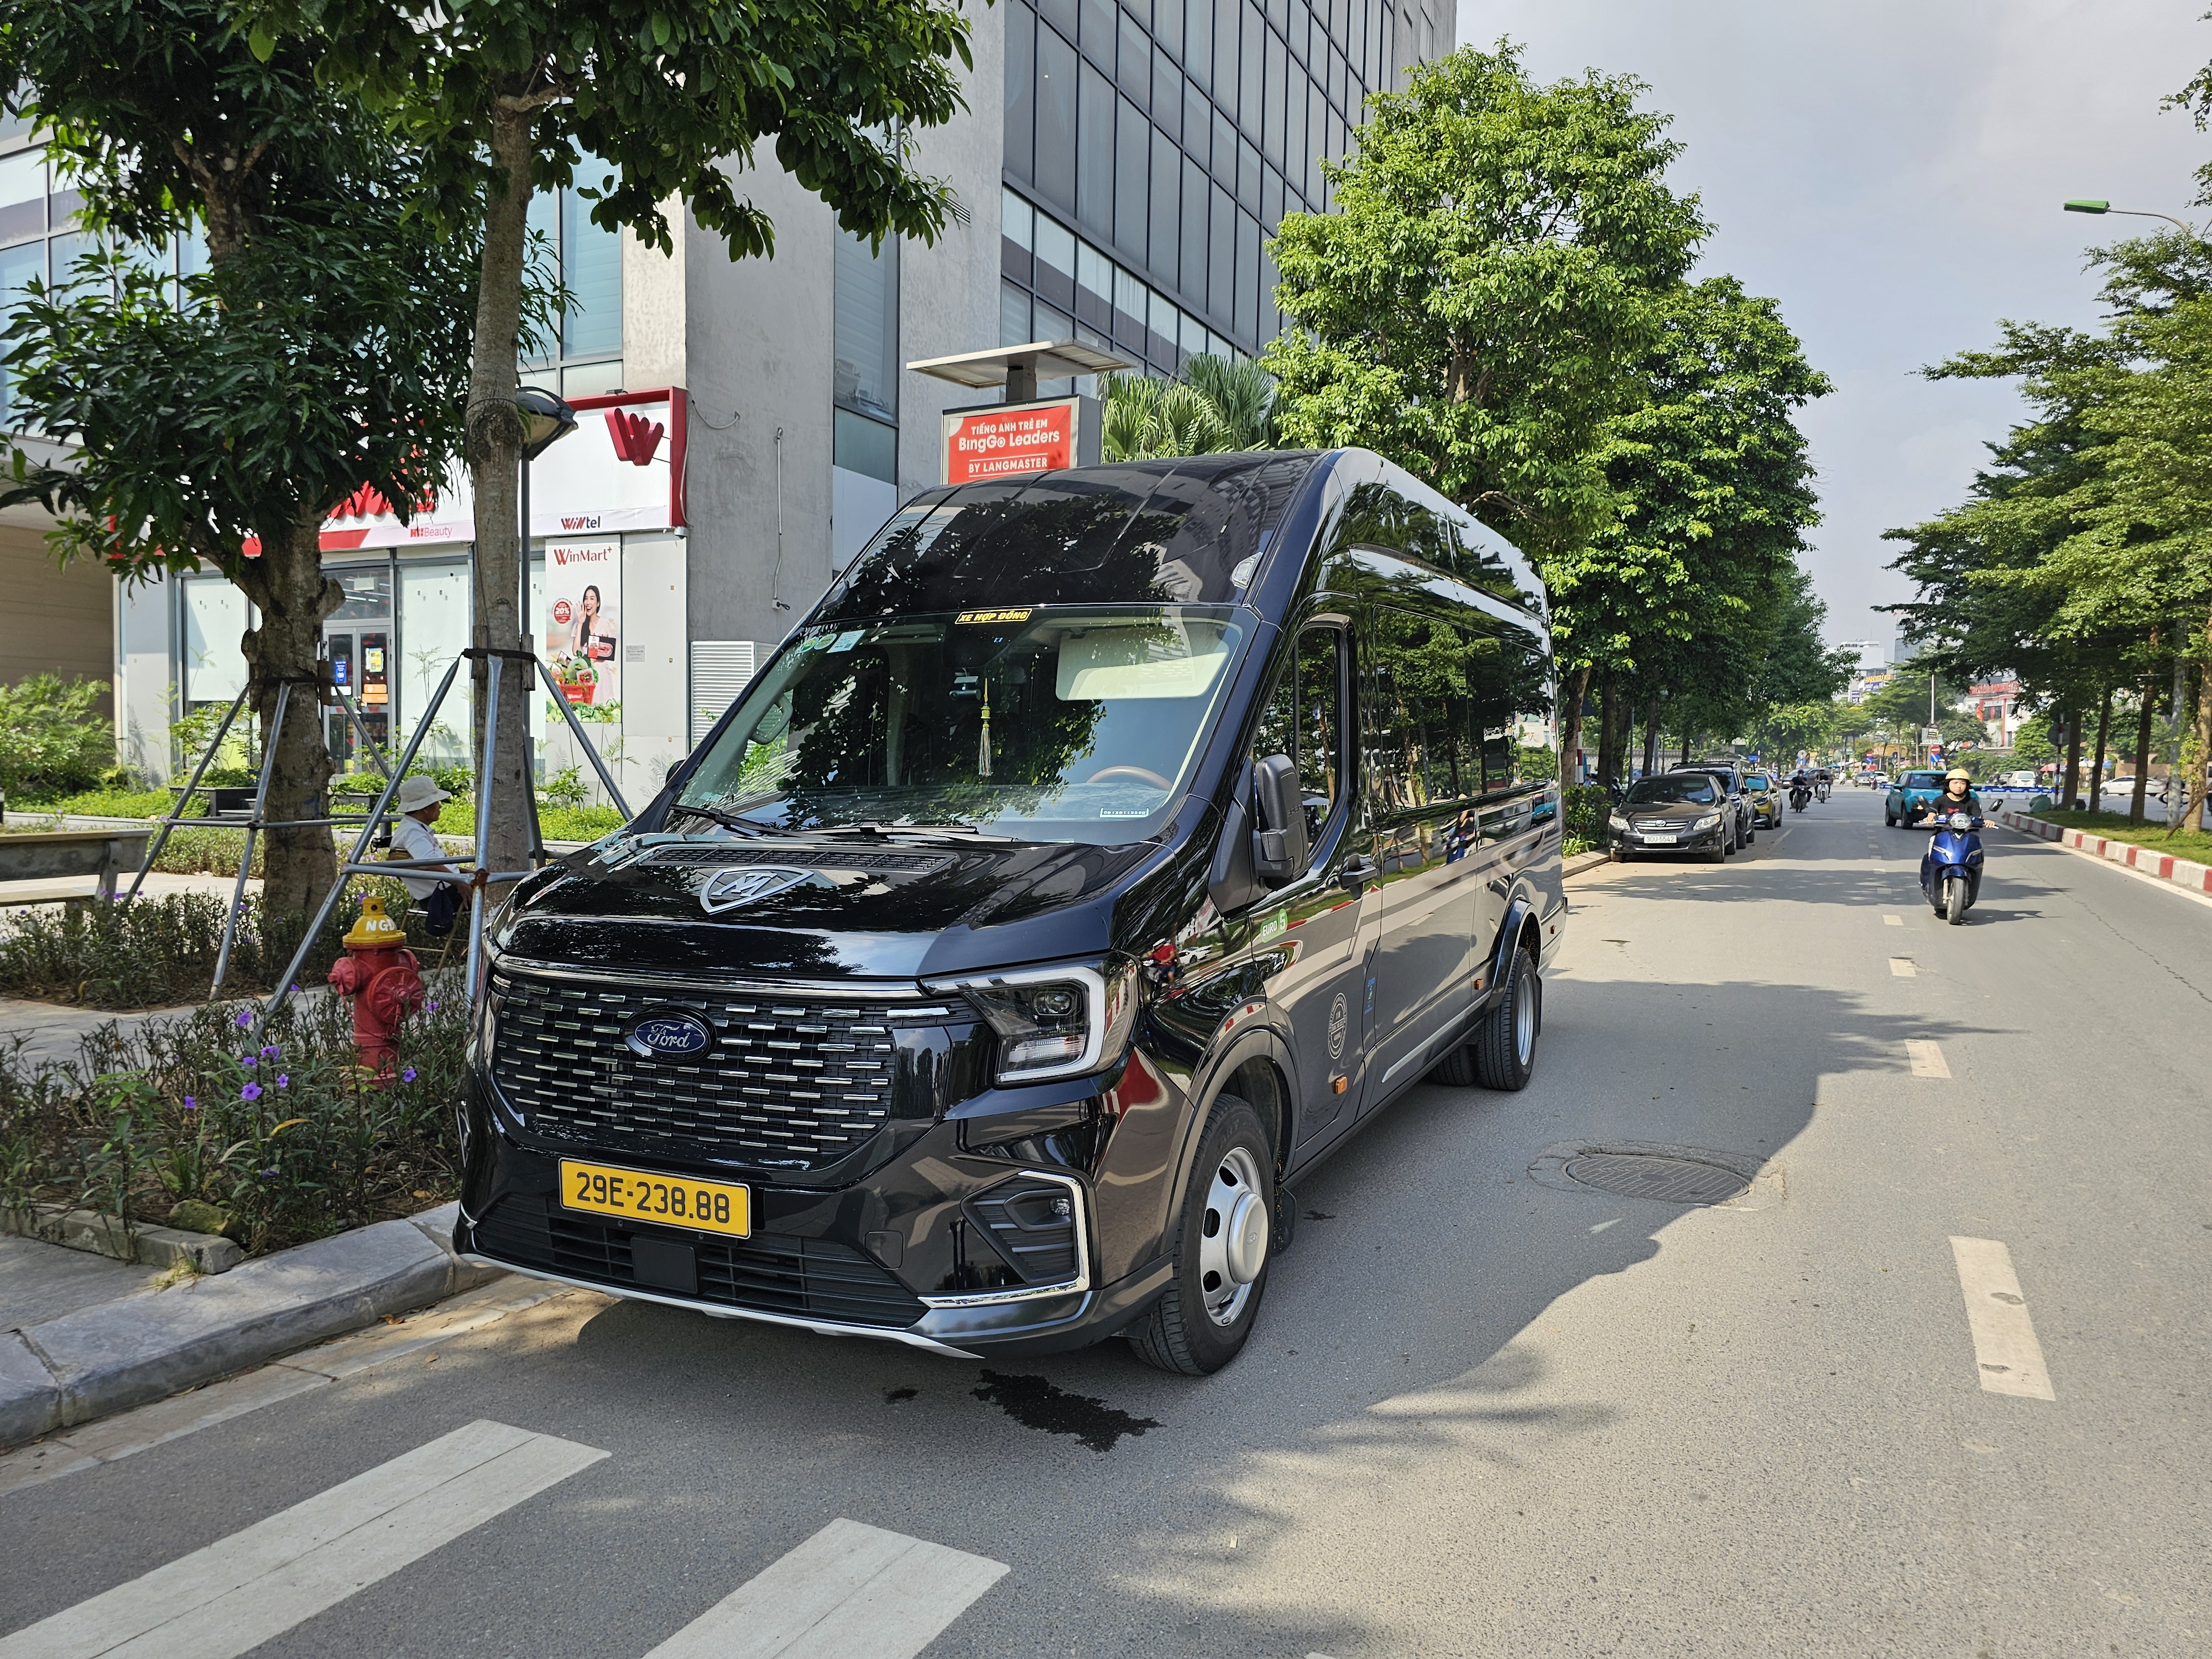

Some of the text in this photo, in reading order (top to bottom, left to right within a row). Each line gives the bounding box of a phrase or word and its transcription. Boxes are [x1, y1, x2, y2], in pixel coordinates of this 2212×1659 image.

[971, 418, 1048, 435] TIẾNG ANH TRẺ EM
[1009, 430, 1060, 447] Leaders
[969, 457, 1048, 473] BY LANGMASTER
[555, 607, 570, 615] 20%
[958, 610, 1028, 622] XE HỢP ĐỒNG
[1262, 912, 1286, 937] EURO 5
[647, 1024, 691, 1048] Ford
[576, 1171, 730, 1224] 29E-238.88
